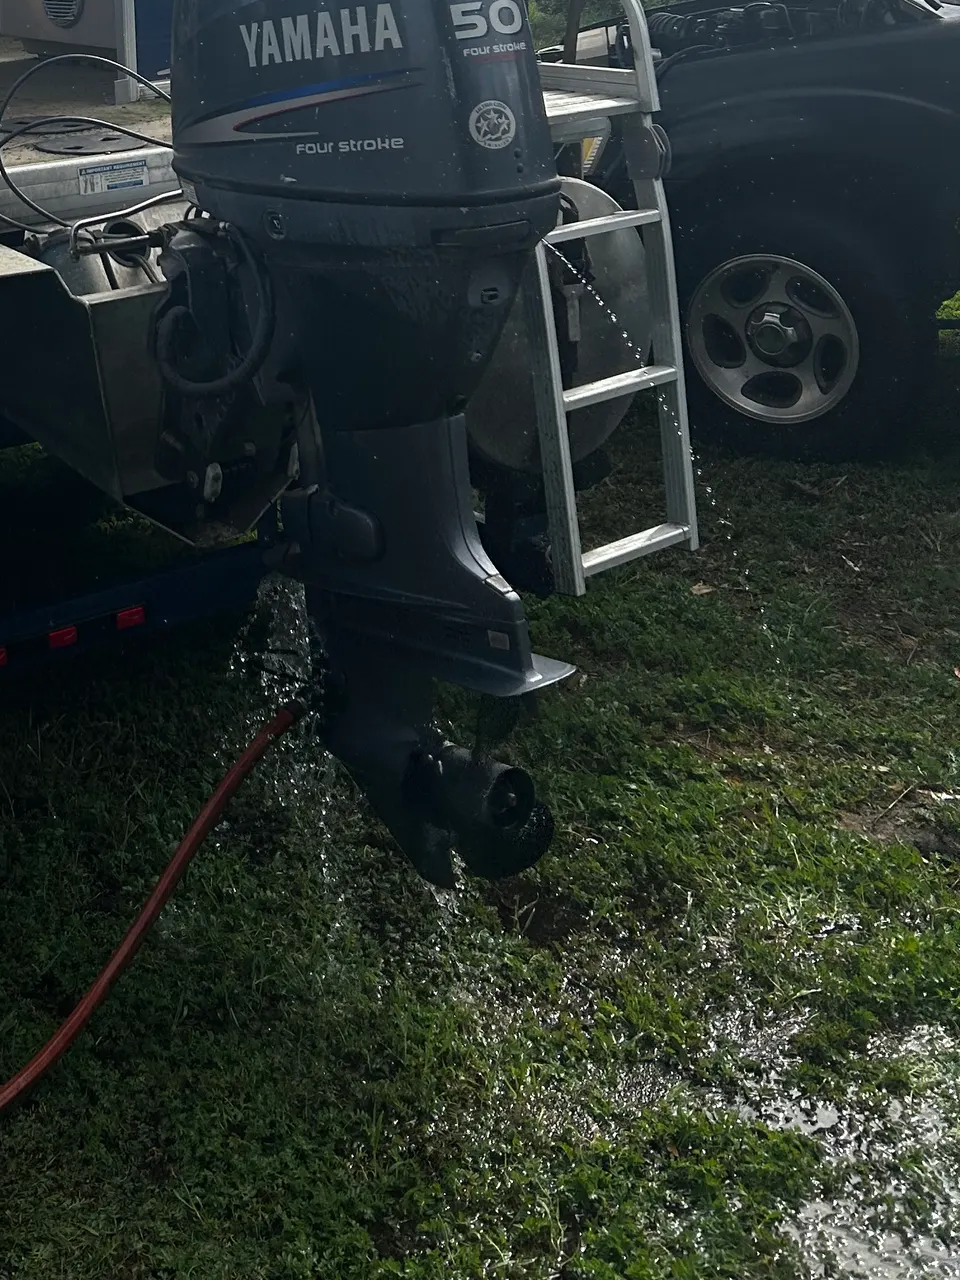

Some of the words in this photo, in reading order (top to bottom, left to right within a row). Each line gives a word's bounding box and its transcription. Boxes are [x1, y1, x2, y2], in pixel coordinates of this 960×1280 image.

[239, 3, 404, 67] YAMAHA
[449, 0, 522, 40] 50
[86, 166, 113, 174] IMPORTANT
